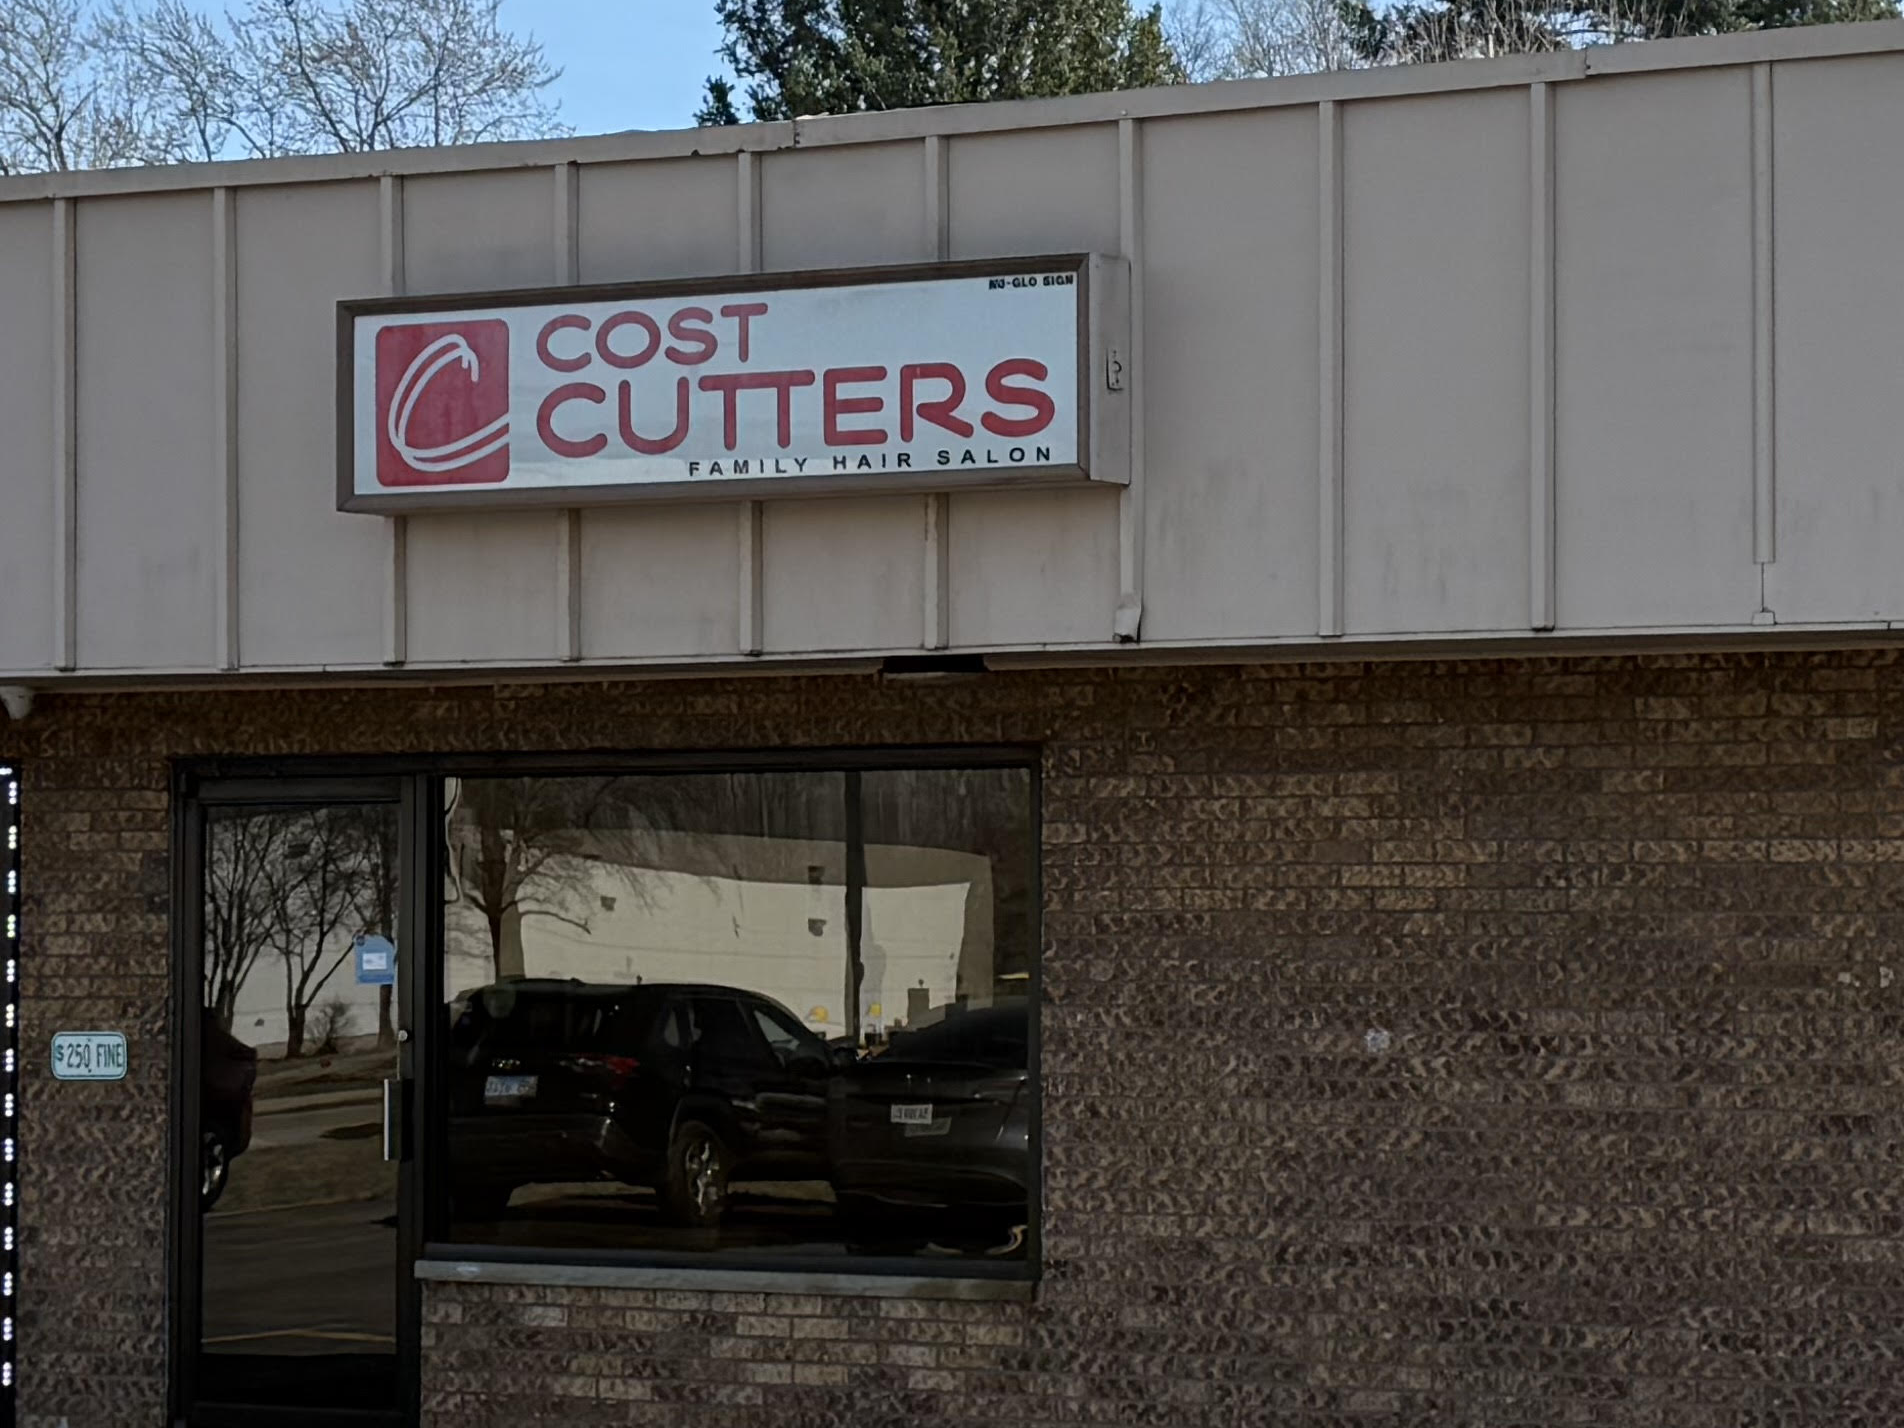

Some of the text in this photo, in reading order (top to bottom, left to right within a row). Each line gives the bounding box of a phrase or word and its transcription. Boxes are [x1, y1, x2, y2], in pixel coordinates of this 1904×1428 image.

[989, 274, 1074, 290] NU-GLO SIGN
[535, 302, 769, 373] COST
[536, 358, 1056, 458] CUTTERS
[689, 447, 1052, 478] FAMILY HAIR SALON
[96, 1043, 123, 1068] FINE
